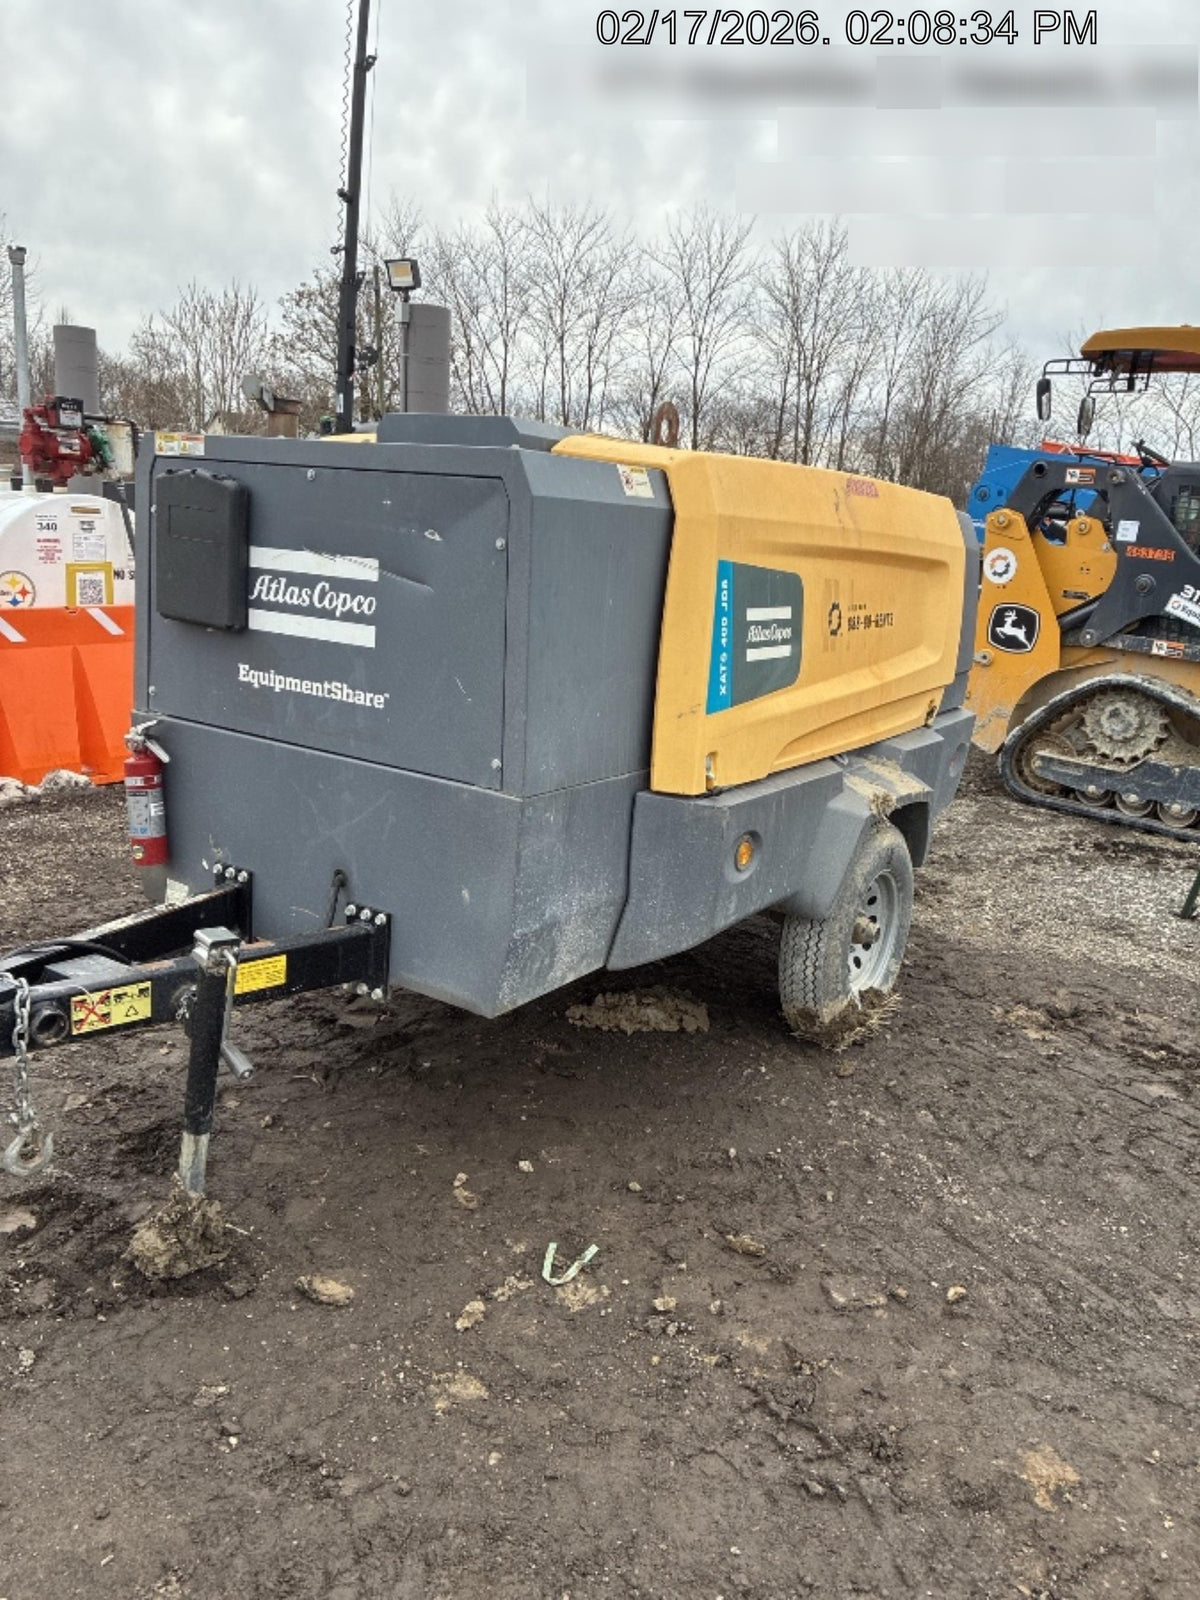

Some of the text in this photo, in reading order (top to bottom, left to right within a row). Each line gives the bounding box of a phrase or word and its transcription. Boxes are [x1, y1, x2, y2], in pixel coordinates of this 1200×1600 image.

[249, 574, 377, 618] Atlas Copco
[720, 616, 729, 648] 400
[238, 662, 386, 709] EquipmentShare
